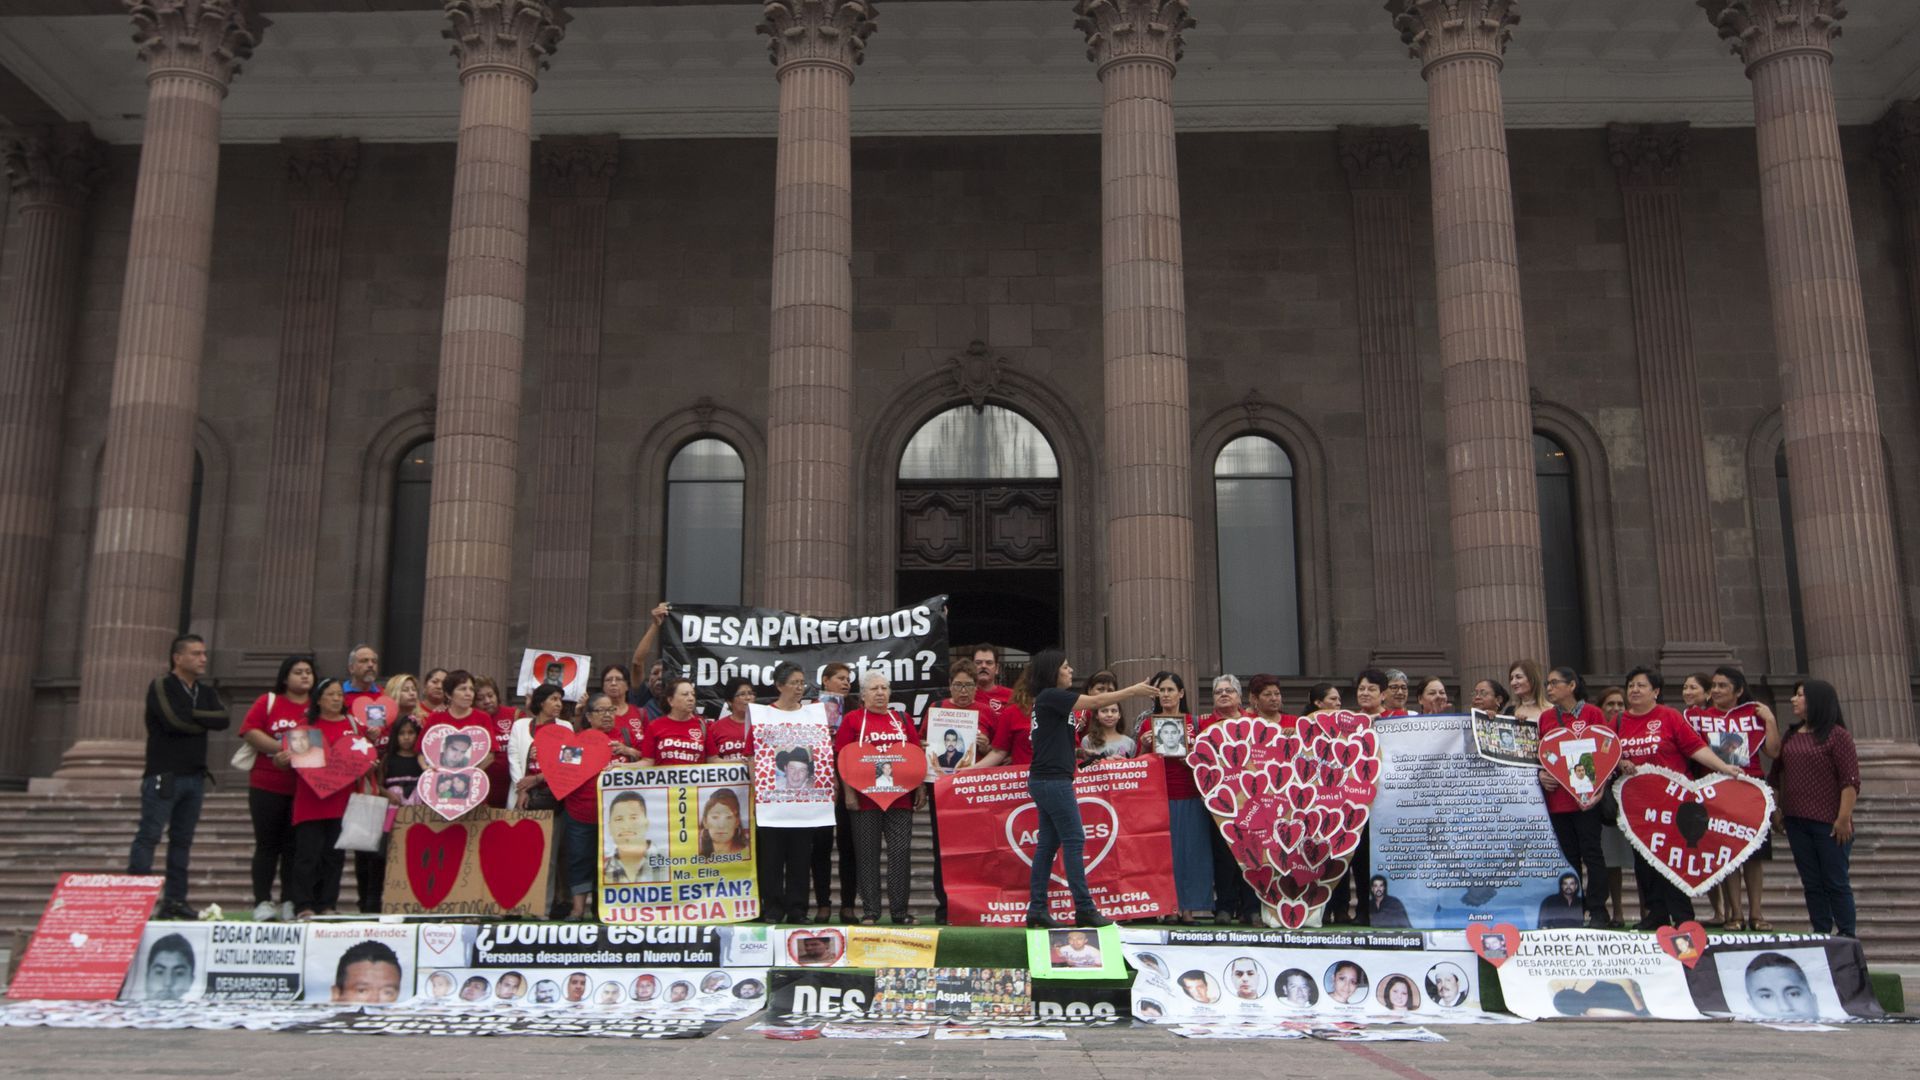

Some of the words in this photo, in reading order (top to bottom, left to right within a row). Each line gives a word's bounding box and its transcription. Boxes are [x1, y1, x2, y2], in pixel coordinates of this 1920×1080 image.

[682, 605, 931, 647] DESAPARECIDOS
[1431, 720, 1460, 731] PARA
[1689, 716, 1765, 734] ISRAEL
[658, 737, 705, 752] ¿Dónde
[660, 750, 700, 763] están?
[1622, 745, 1659, 759] stán?
[1394, 763, 1441, 773] comprender
[1452, 760, 1495, 770] verdadero
[602, 766, 751, 788] DESAPARECIERON
[952, 771, 1017, 785] AGRUPACIÓN
[1385, 772, 1408, 782] dolor
[1409, 771, 1444, 783] espiritual
[1446, 771, 1458, 779] del
[1459, 769, 1509, 778] sufrimiento
[955, 784, 977, 795] POR
[978, 783, 998, 793] LOS
[1075, 784, 1110, 795] NUEVO
[1112, 780, 1139, 792] LEÓN
[1397, 781, 1430, 790] nosotros
[1441, 780, 1485, 789] esperanza
[1486, 778, 1499, 787] de
[1500, 778, 1527, 787] volver
[1419, 789, 1468, 799] comprender
[1469, 788, 1479, 796] tu
[1481, 787, 1518, 796] voluntad
[1666, 781, 1717, 803] HIJO
[967, 795, 974, 804] Y
[1444, 798, 1483, 807] nosotros
[1484, 797, 1493, 805] la
[1494, 796, 1528, 805] caridad
[1529, 796, 1545, 806] que
[1435, 808, 1452, 816] nos
[1453, 807, 1474, 817] haga
[1475, 805, 1503, 814] sentir
[1644, 808, 1672, 824] ME
[1398, 818, 1407, 826] tu
[1408, 817, 1447, 828] presencia
[1448, 816, 1460, 825] en
[1461, 815, 1495, 824] nuestro
[1528, 814, 1549, 824] para
[1497, 824, 1508, 832] no
[1510, 823, 1550, 833] permitas
[1708, 818, 1758, 841] HACES
[1390, 836, 1400, 844] su
[1400, 834, 1437, 844] ausencia
[1438, 834, 1450, 842] no
[1452, 833, 1475, 844] quite
[1476, 832, 1485, 841] el
[1515, 831, 1527, 841] de
[1528, 831, 1550, 841] vivir
[1379, 844, 1416, 855] destruya
[1417, 844, 1449, 853] nuestra
[1449, 843, 1492, 852] confianza
[1494, 843, 1506, 851] en
[1524, 842, 1558, 851] reconfo
[1650, 832, 1732, 876] FALTA
[649, 855, 687, 868] Edson
[690, 855, 706, 865] de
[708, 852, 743, 864] Jesus
[1393, 854, 1430, 863] nuestros
[1430, 852, 1475, 862] familiares
[1482, 851, 1515, 861] ilumina
[1517, 851, 1527, 860] el
[1385, 862, 1418, 873] quienes
[1418, 862, 1448, 871] elevan
[1449, 861, 1466, 870] una
[1501, 861, 1517, 870] por
[1518, 859, 1552, 869] Ramiro
[673, 868, 694, 881] Ma.
[1390, 872, 1406, 882] que
[1406, 872, 1418, 880] no
[1420, 871, 1431, 880] se
[1432, 870, 1461, 881] pierda
[1462, 870, 1471, 878] la
[1472, 869, 1518, 880] esperanza
[1518, 869, 1531, 878] de
[1531, 869, 1560, 880] seguir
[604, 885, 672, 905] DONDE
[679, 878, 753, 902] ESTÁN?
[1426, 880, 1473, 890] esperando
[1473, 880, 1484, 888] su
[1485, 879, 1522, 889] regreso.
[1051, 899, 1071, 909] EN
[1100, 891, 1150, 906] LUCHA
[604, 901, 727, 922] JUSTICIA
[734, 899, 756, 918] !!!
[212, 925, 252, 944] EDGAR
[256, 926, 302, 945] DAMIAN
[315, 929, 360, 939] Miranda
[1170, 931, 1214, 942] Personas
[1215, 931, 1227, 941] de
[1229, 932, 1258, 942] Nuevo
[1260, 932, 1282, 943] León
[1284, 933, 1352, 946] Desaparecidas
[1354, 937, 1366, 946] en
[1367, 935, 1421, 948] Tamaulipas
[1598, 943, 1664, 957] MORALE
[214, 949, 250, 965] CASTILLO
[252, 949, 296, 966] RODRIGUEZ
[479, 950, 534, 964] Personas
[536, 950, 622, 966] desaparecidas
[625, 953, 642, 963] en
[643, 950, 682, 963] Nuevo
[684, 950, 713, 963] León
[1516, 959, 1587, 969] DESAPARECIO
[1591, 958, 1661, 968] 26-JUNIO-2010
[1528, 968, 1542, 977] EN
[1544, 968, 1578, 977] SANTA
[215, 977, 277, 991] DESAPARECIO
[278, 978, 291, 992] EL
[937, 991, 972, 1004] Aspek
